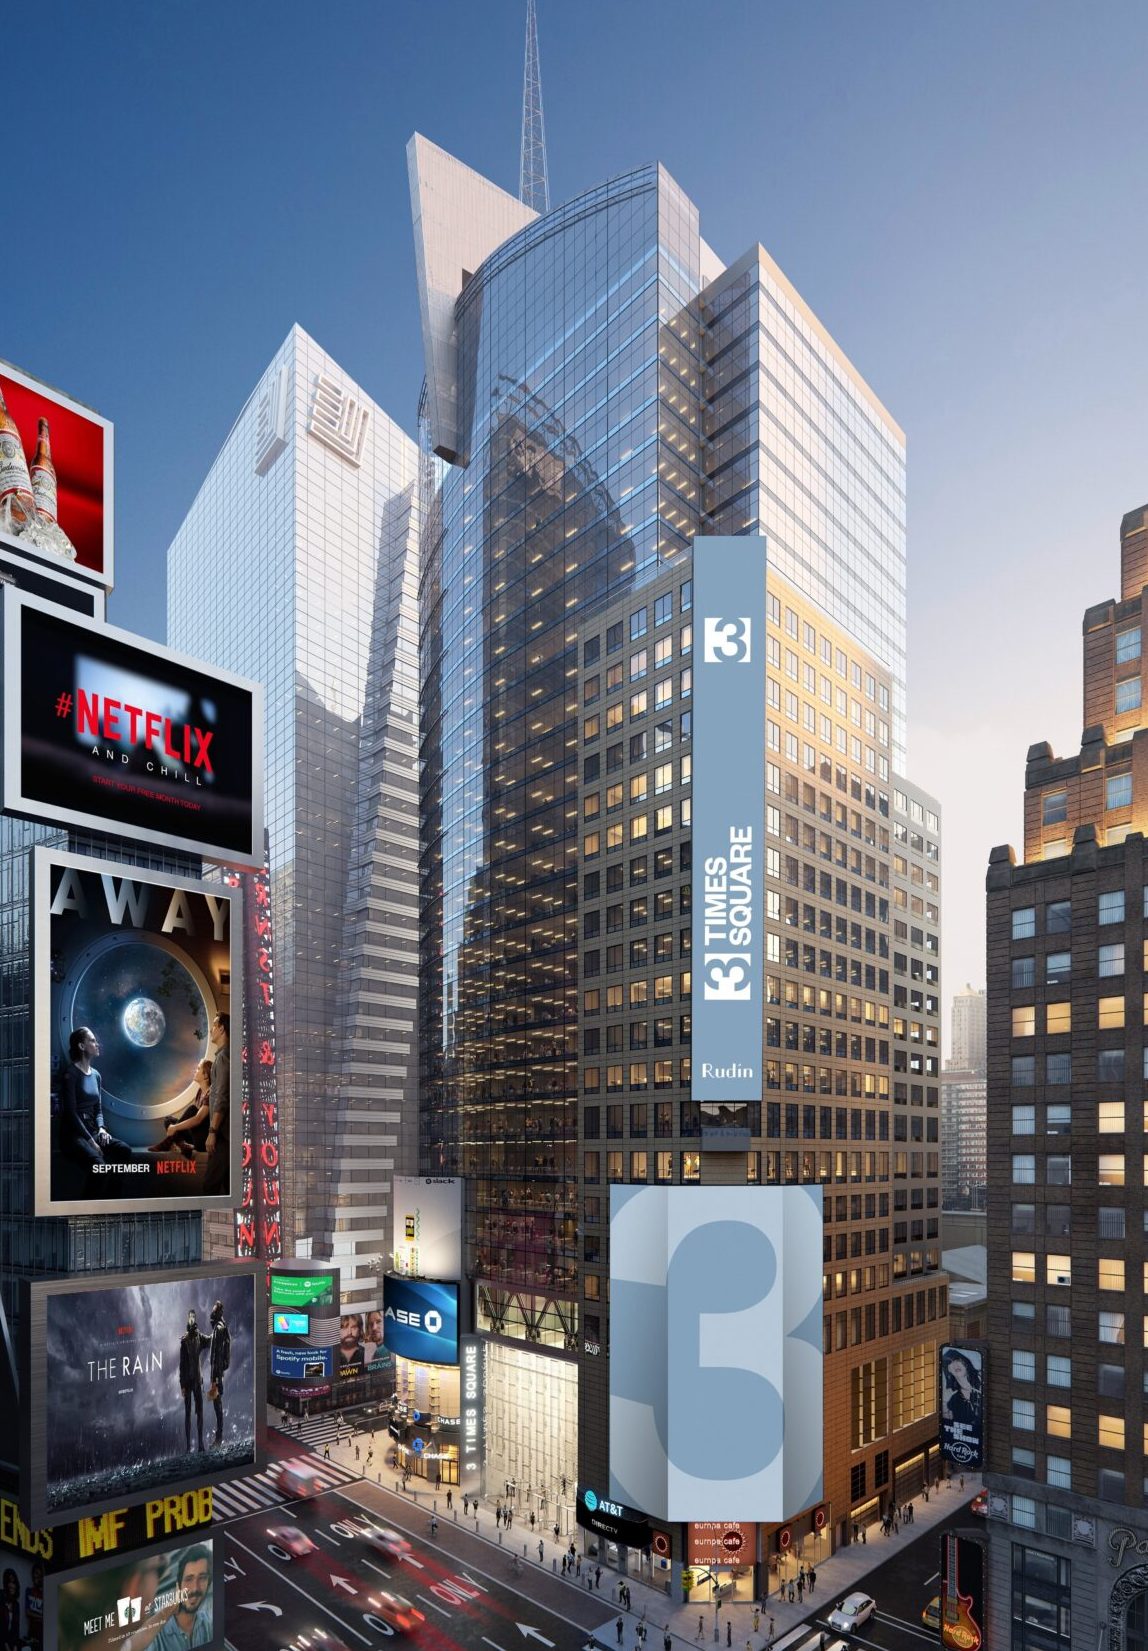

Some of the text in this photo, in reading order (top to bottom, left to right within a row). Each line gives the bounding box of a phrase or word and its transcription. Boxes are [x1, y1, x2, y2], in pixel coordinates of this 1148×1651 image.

[704, 617, 751, 663] 3
[55, 688, 213, 775] #NETFLIX
[92, 745, 202, 786] AND CHILL
[50, 867, 230, 941] AWAY
[729, 826, 752, 946] SQUARE
[704, 856, 751, 1000] 3 TIMES
[702, 1063, 753, 1079] Rudin
[92, 1160, 197, 1175] SEPTEMBER NETFLIX
[87, 1350, 163, 1382] THE RAIN
[276, 1354, 301, 1363] Spotify
[466, 1345, 478, 1471] 3 TIMES SQUARE
[944, 1442, 979, 1459] Hard Rock
[78, 1508, 129, 1558] IMF
[145, 1486, 213, 1539] PROB
[591, 1518, 618, 1535] DIRECTV
[598, 1500, 624, 1517] AT&T
[723, 1537, 740, 1545] cafe
[429, 1572, 489, 1605] ONLY
[83, 1615, 103, 1637] MEET
[104, 1611, 116, 1629] ME
[154, 1587, 189, 1613] STARBUCKS
